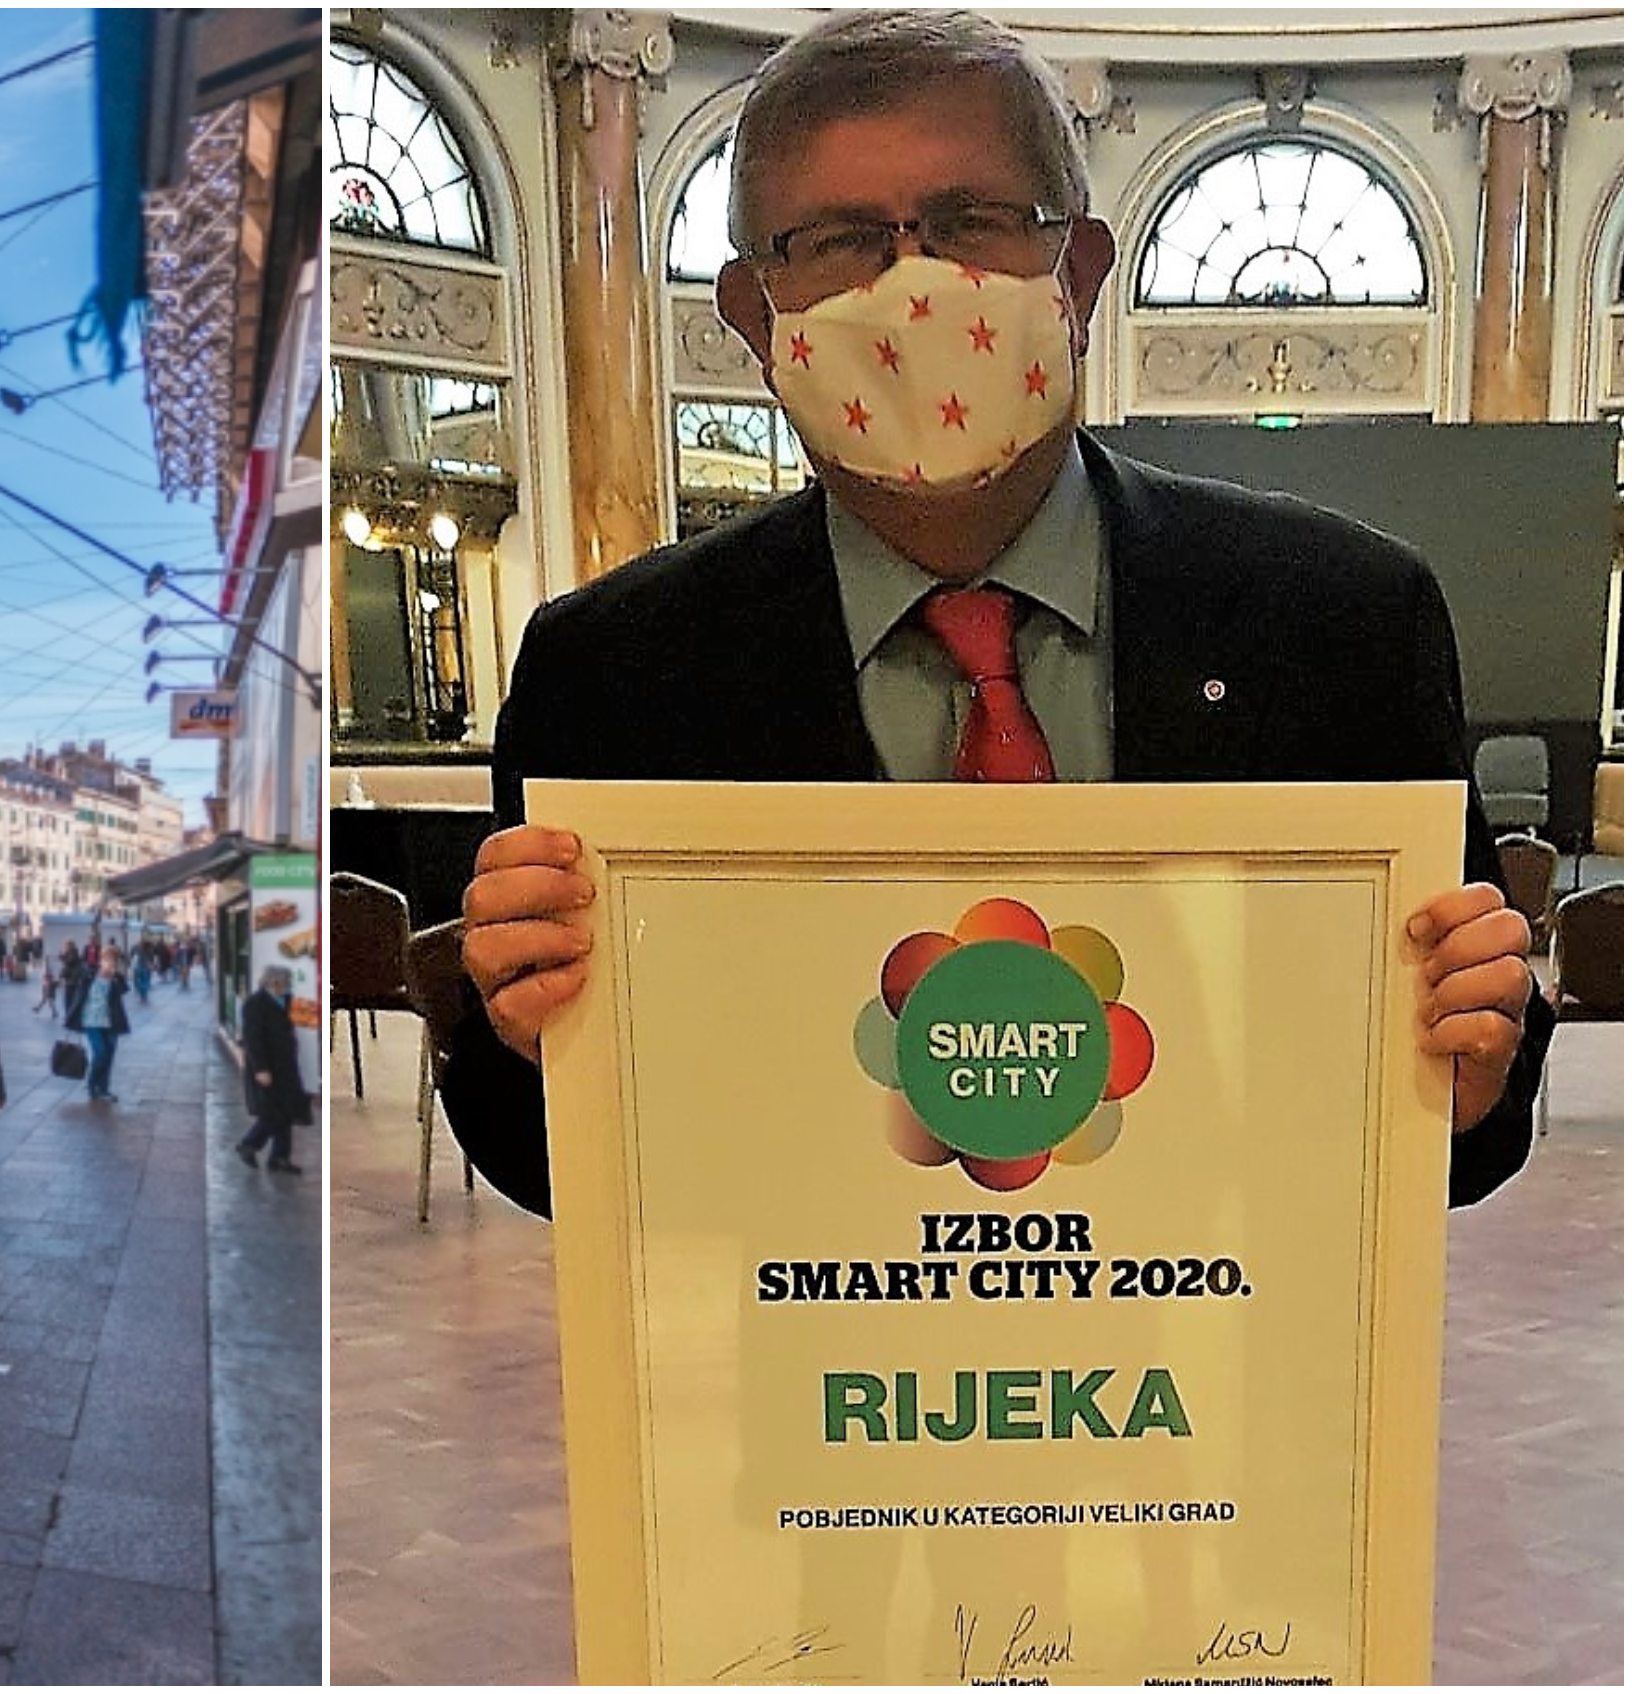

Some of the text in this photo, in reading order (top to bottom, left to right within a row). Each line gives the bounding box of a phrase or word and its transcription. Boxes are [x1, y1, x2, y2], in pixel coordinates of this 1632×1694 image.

[189, 696, 235, 720] dm
[928, 1021, 1088, 1061] SMART
[949, 1066, 1062, 1099] CITY
[920, 1213, 1094, 1255] IZBOR
[758, 1258, 1252, 1302] SMART CITY 2020.
[823, 1369, 1194, 1442] RIJEKA
[779, 1502, 1236, 1529] POBJEDNIK U KATEGORIJI VELIKI GRAD
